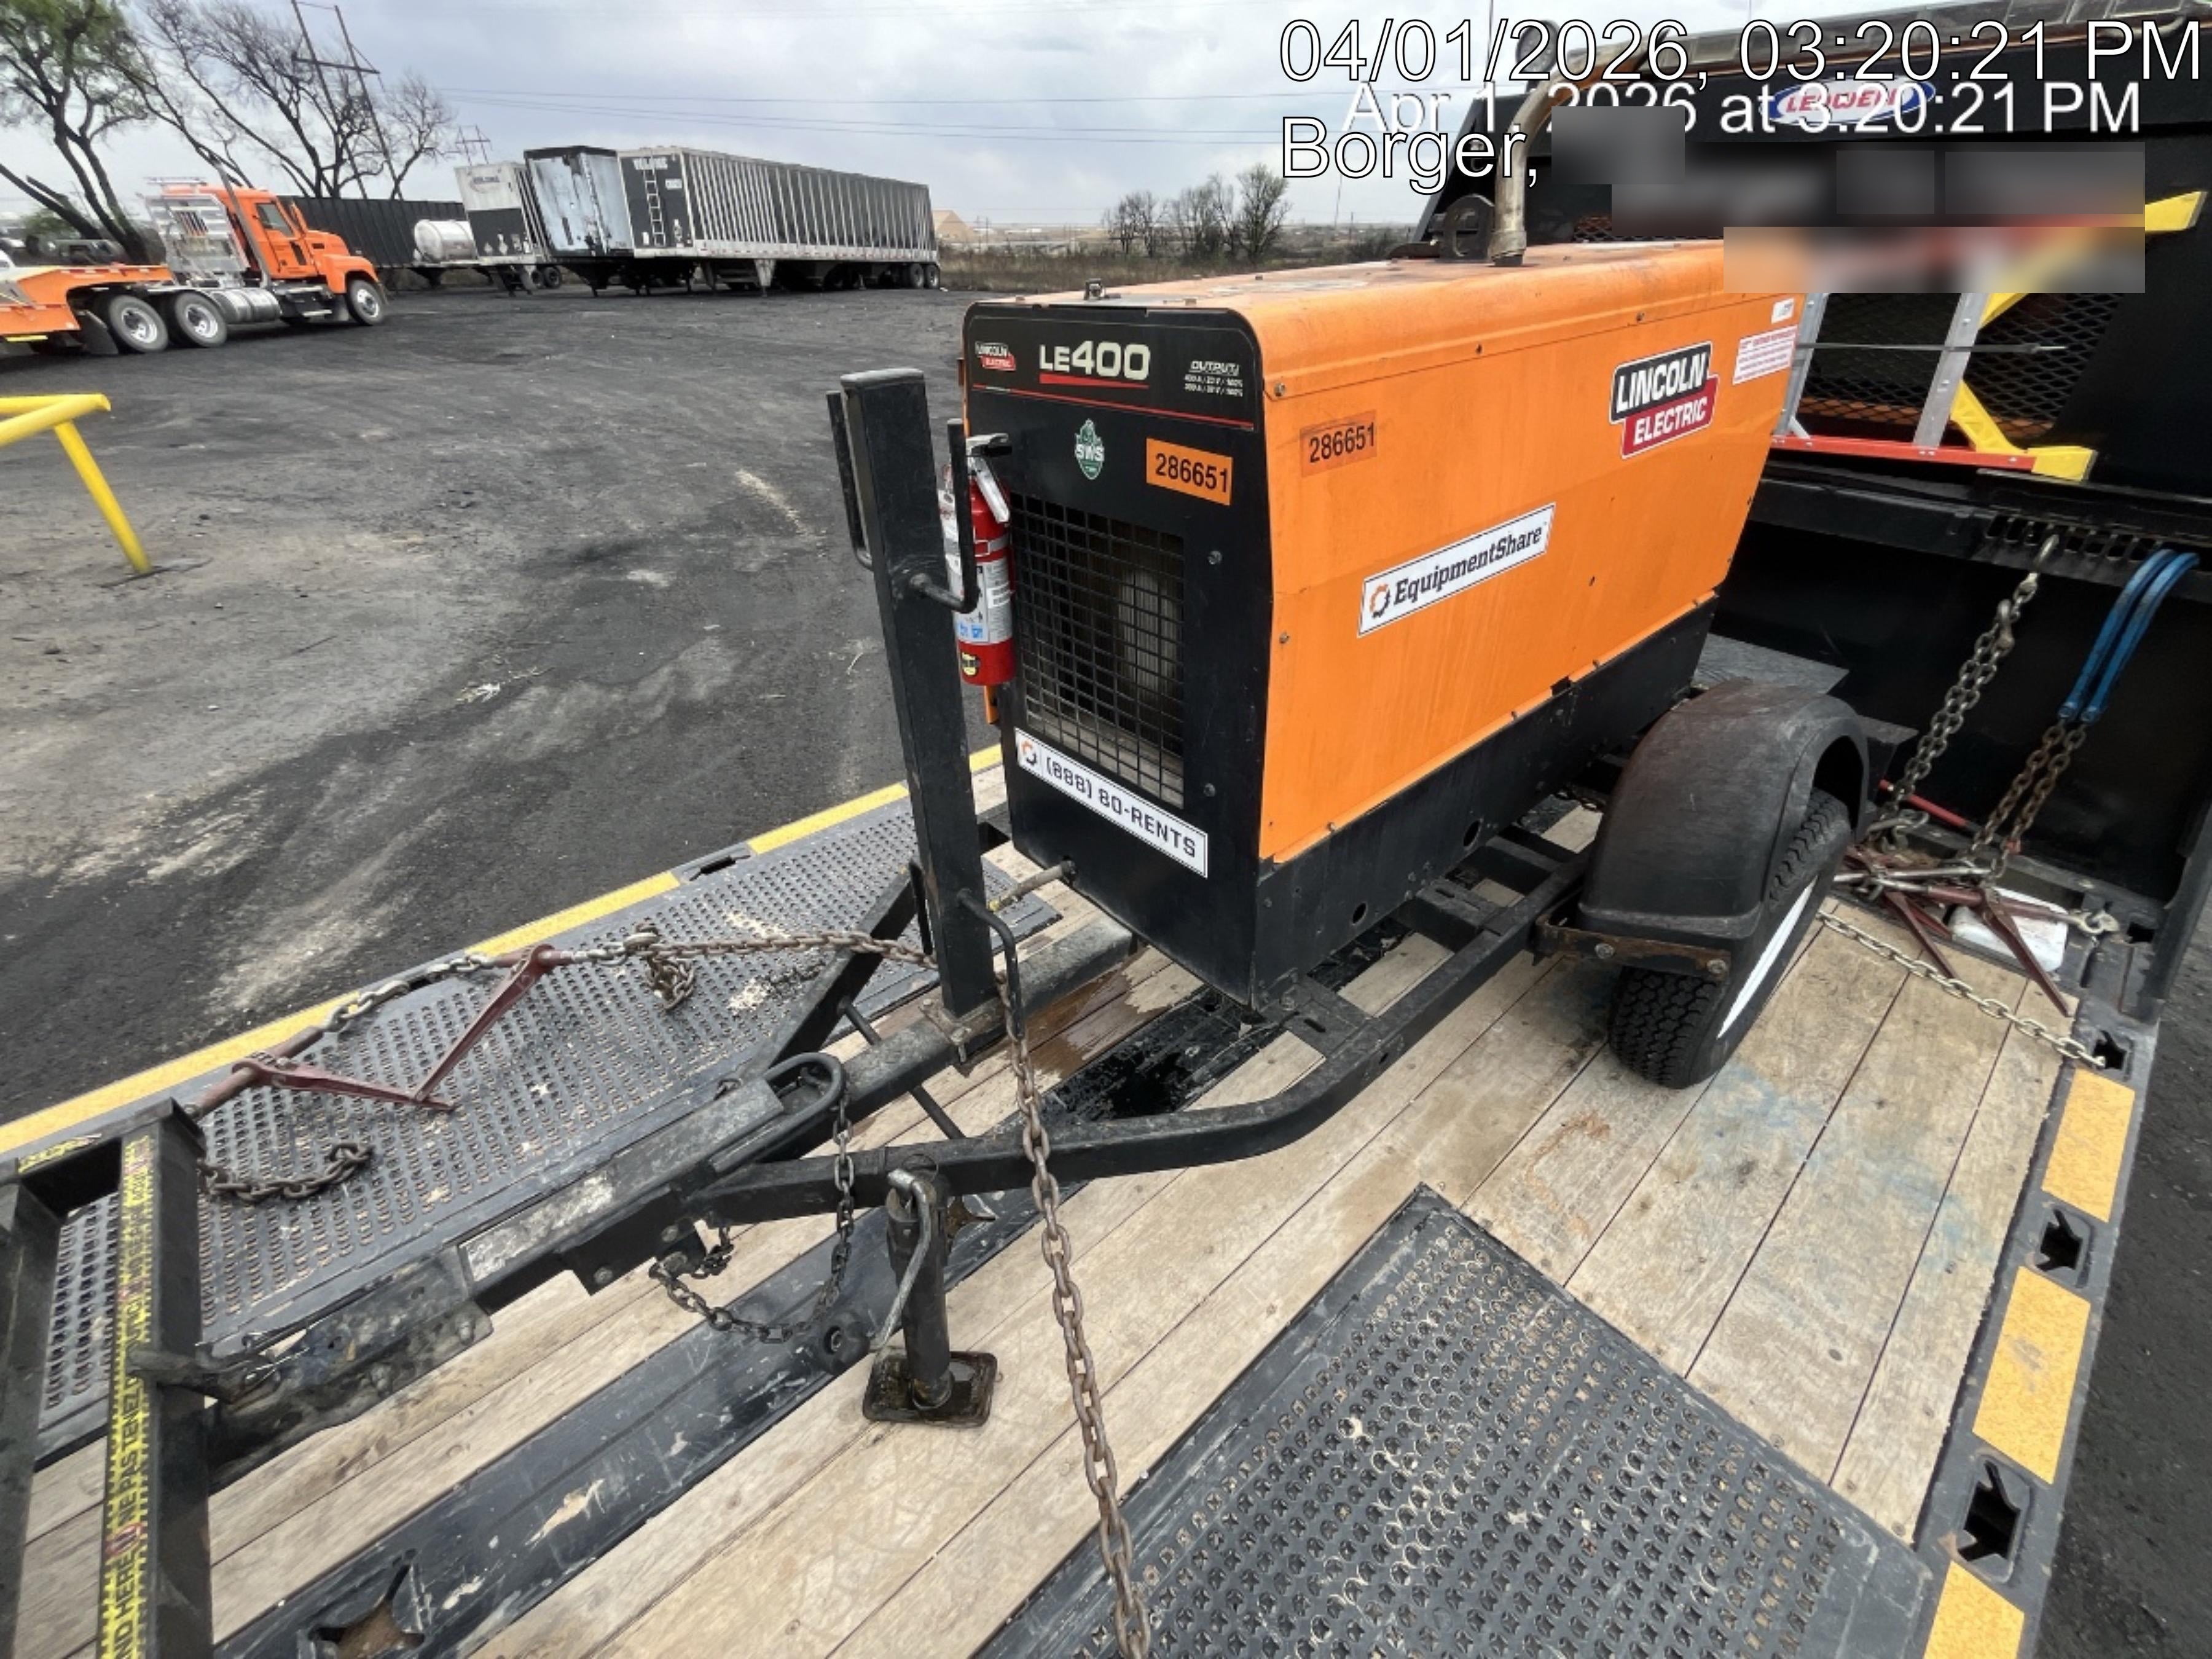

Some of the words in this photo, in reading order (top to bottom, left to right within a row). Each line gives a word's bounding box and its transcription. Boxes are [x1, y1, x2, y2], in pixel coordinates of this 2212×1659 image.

[1040, 340, 1150, 380] LE400
[1617, 351, 1708, 414] LINCOLN
[1309, 422, 1375, 463] 286651
[1633, 396, 1708, 446] ELECTRIC
[1155, 452, 1228, 493] 286651
[1393, 527, 1543, 605] EquipmentShare
[1046, 756, 1092, 799] (888)
[1099, 788, 1196, 858] 80-RENTS
[115, 1548, 135, 1618] HERE
